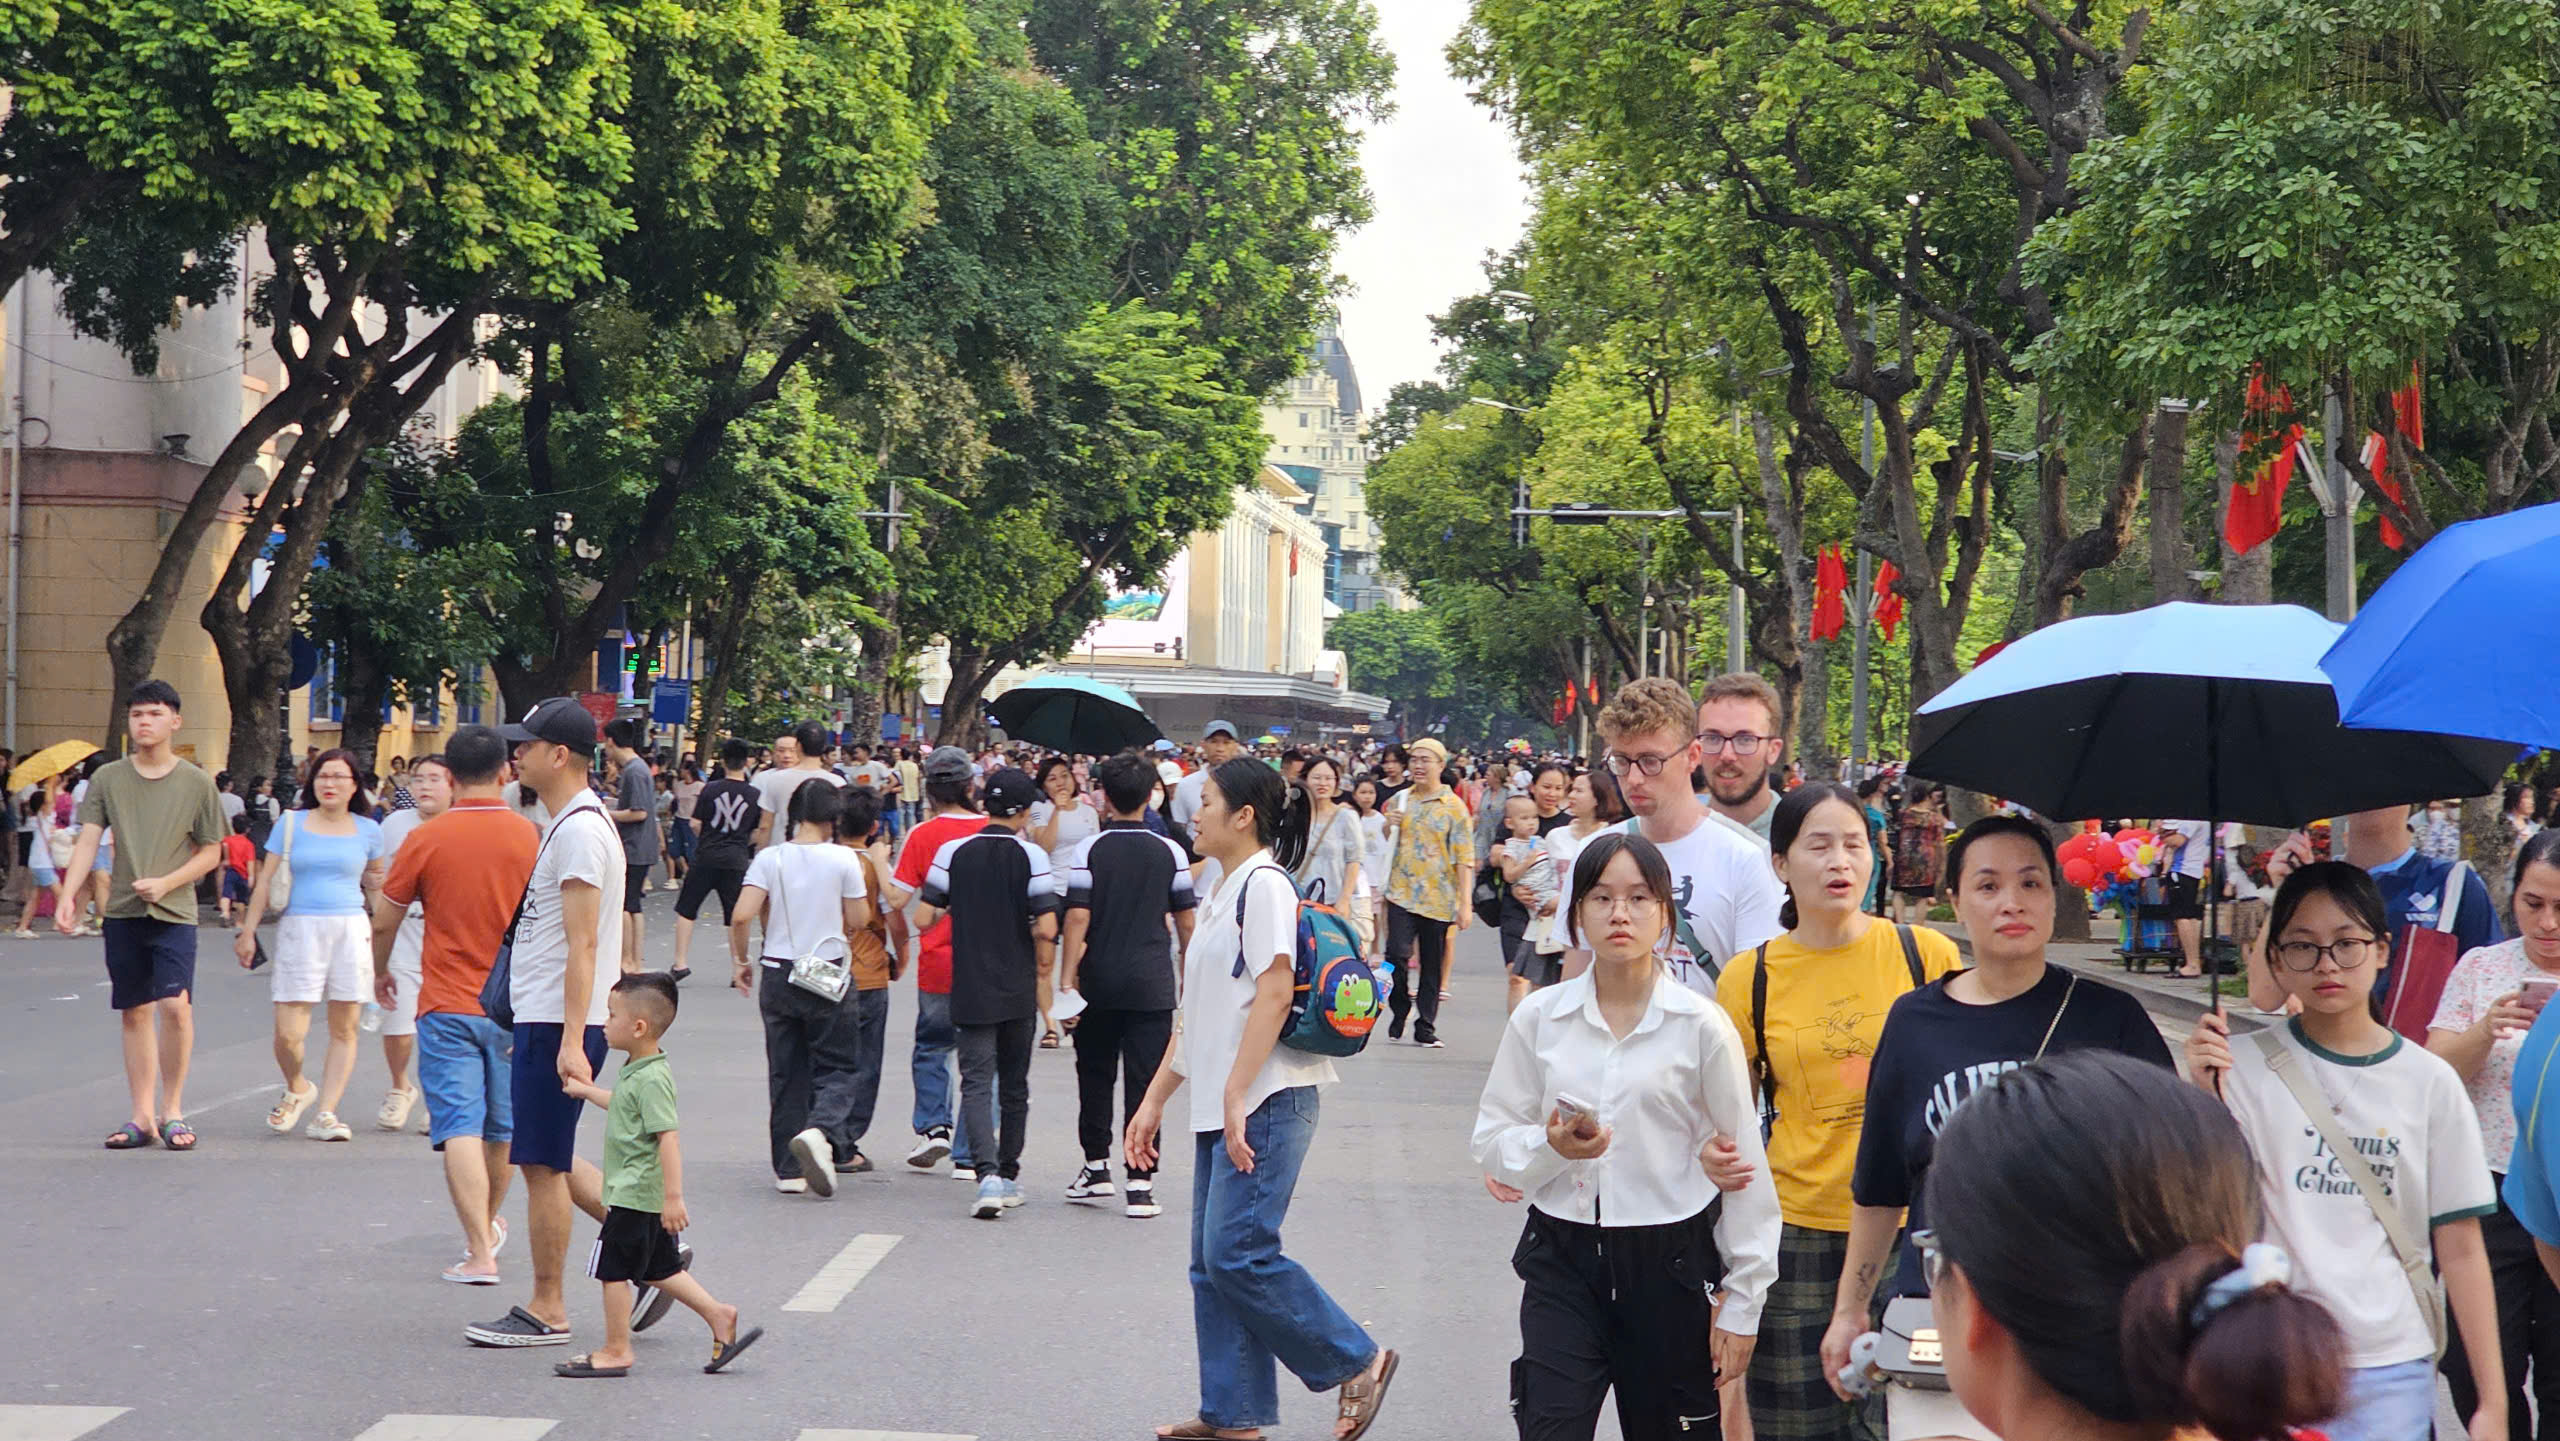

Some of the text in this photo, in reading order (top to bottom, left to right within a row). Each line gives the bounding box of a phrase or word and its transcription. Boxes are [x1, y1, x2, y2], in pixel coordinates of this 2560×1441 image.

[710, 791, 749, 833] NY
[1924, 1060, 2030, 1137] CALIF
[491, 1334, 532, 1345] crocs
